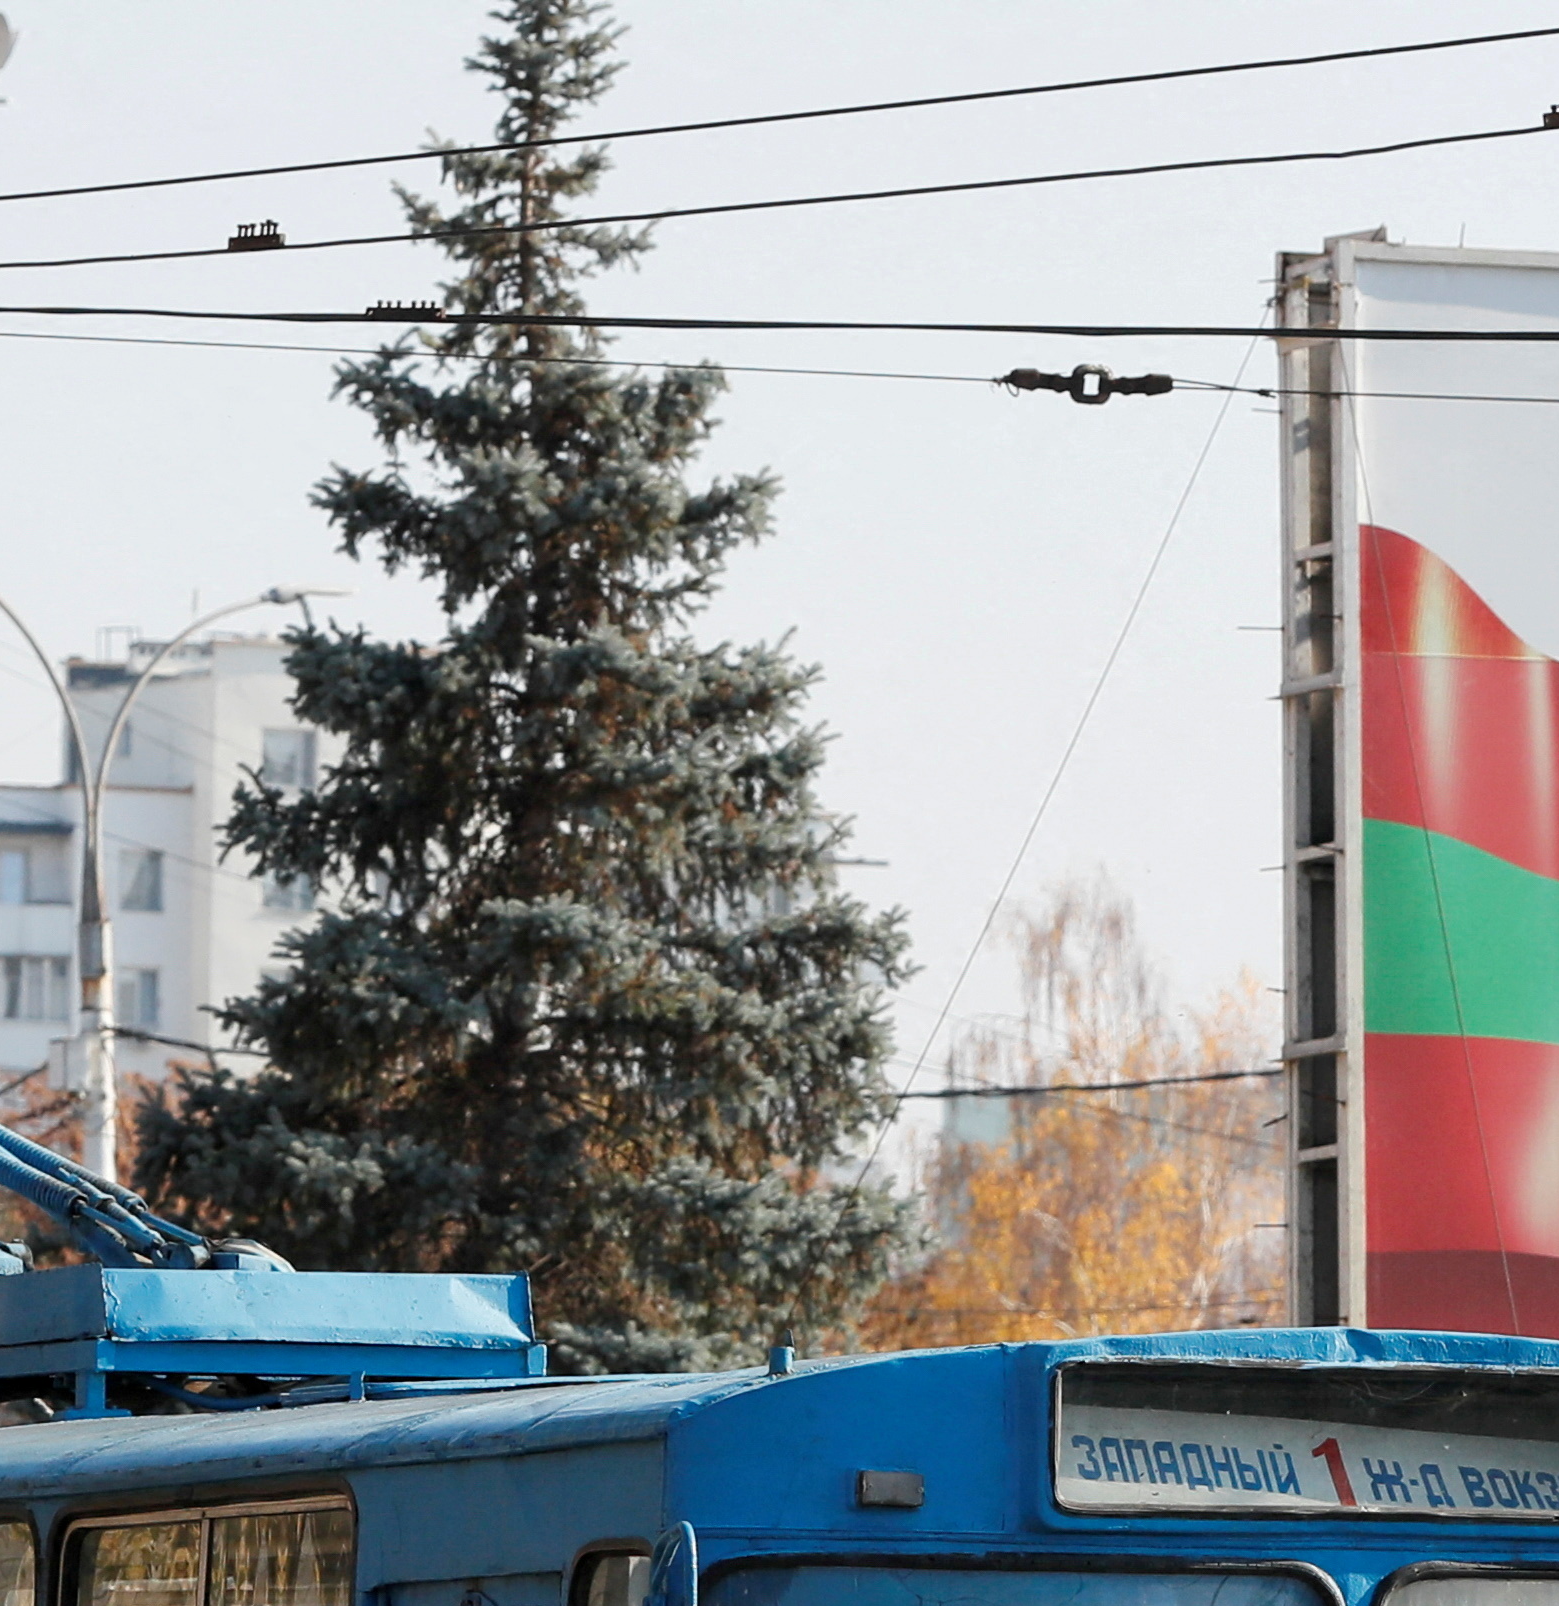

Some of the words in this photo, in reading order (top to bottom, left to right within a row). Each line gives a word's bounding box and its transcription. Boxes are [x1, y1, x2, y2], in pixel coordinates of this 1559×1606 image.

[1070, 1434, 1301, 1496] ЗАПАДНЫЙ
[1312, 1437, 1358, 1506] 1
[1362, 1457, 1453, 1509] Ж-Д
